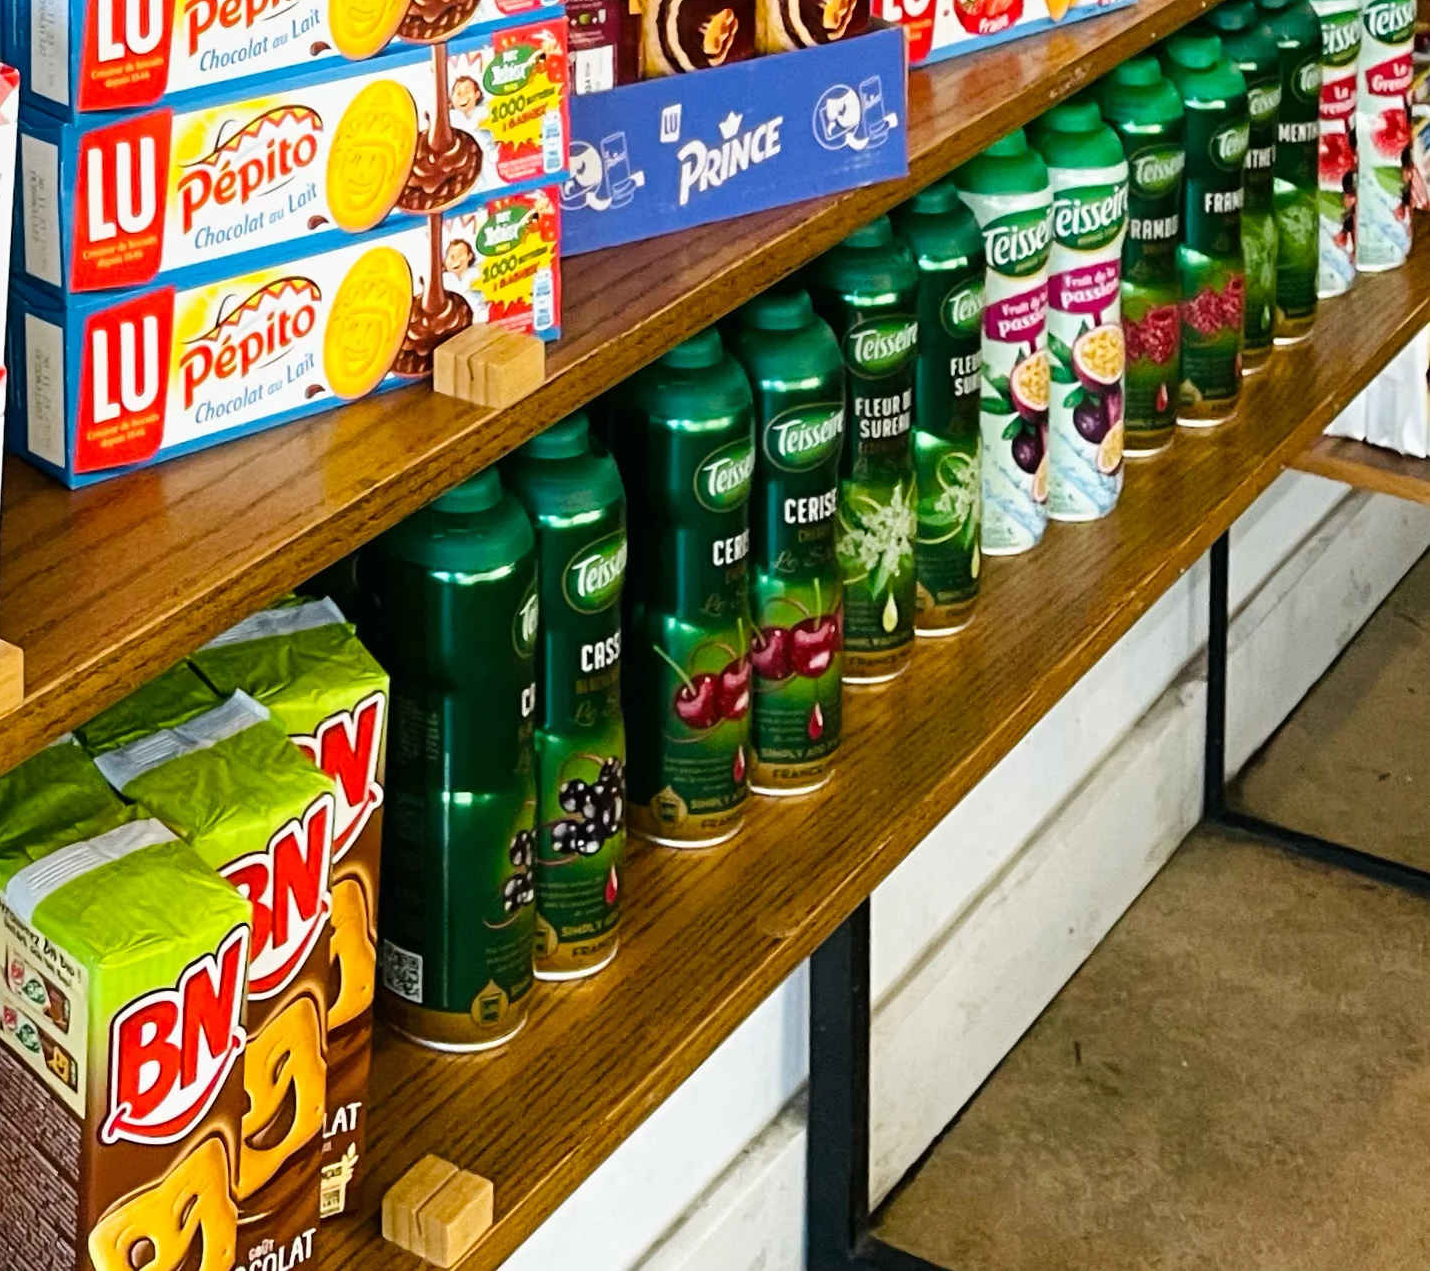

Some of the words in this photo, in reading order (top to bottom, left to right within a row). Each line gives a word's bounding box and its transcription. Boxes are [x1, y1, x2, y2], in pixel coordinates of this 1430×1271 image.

[87, 136, 158, 243] LU
[176, 133, 318, 234] Pépito
[678, 115, 784, 207] PRINCE
[194, 211, 265, 250] Chocolat
[268, 208, 285, 225] au
[288, 183, 318, 218] Lait
[92, 315, 159, 424] LU
[179, 302, 317, 411] Pépito
[854, 393, 898, 418] FLEUR
[116, 937, 243, 1119] BN
